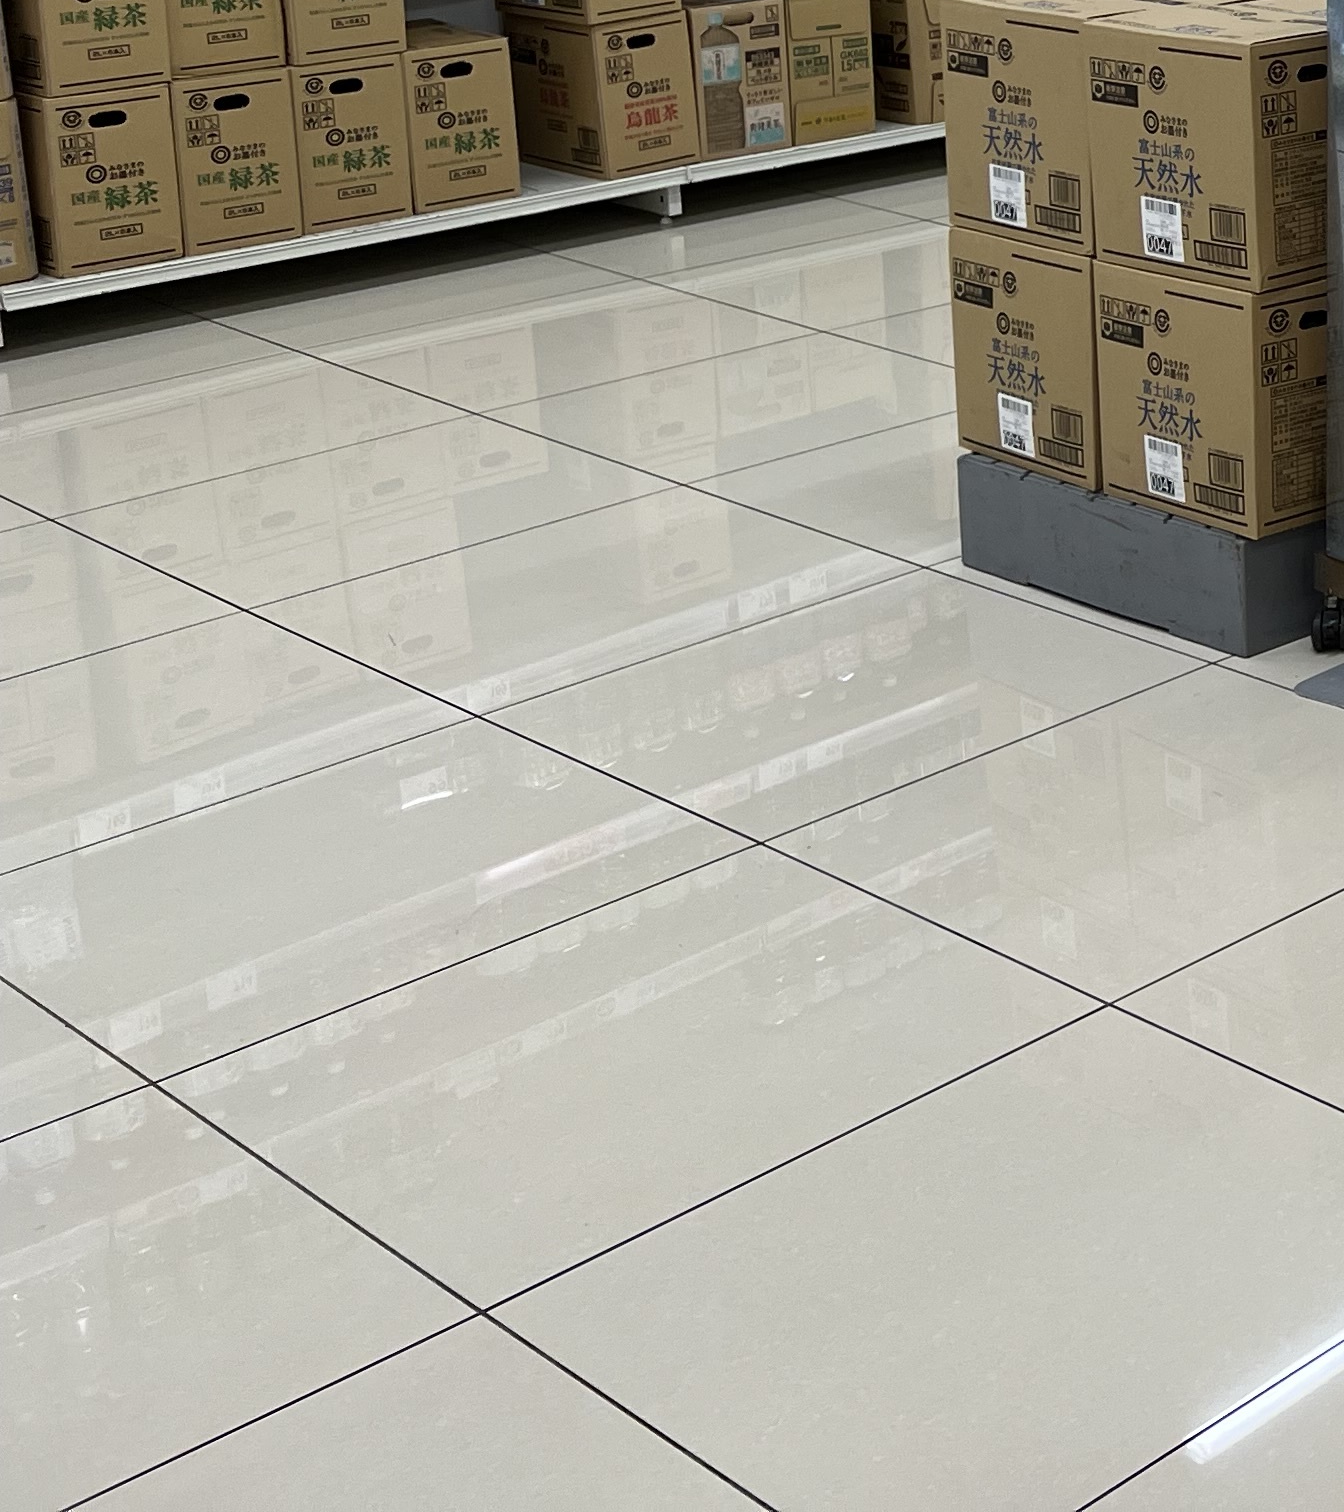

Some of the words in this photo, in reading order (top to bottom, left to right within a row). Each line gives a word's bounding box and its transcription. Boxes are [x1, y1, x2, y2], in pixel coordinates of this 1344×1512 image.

[59, 9, 91, 27] 国産
[92, 2, 148, 33] 緑茶
[624, 104, 680, 131] 烏龍茶
[987, 106, 1038, 130] 富士山系の
[424, 136, 451, 151] 国産
[453, 127, 501, 156] 緑茶
[982, 124, 1045, 164] 天然水
[1137, 137, 1196, 162] 富士山系の
[311, 153, 340, 170] 国産
[342, 143, 392, 174] 緑茶
[196, 170, 227, 188] 国産
[227, 161, 281, 193] 緑茶
[1133, 157, 1204, 197] 天然水
[71, 190, 103, 207] 国産
[103, 180, 160, 212] 緑茶
[1146, 233, 1174, 255] 0047
[991, 337, 1041, 364] 富士山系の
[986, 355, 1047, 398] 天然水
[1140, 379, 1197, 405] 富士山系の
[1136, 395, 1203, 440] 天然水
